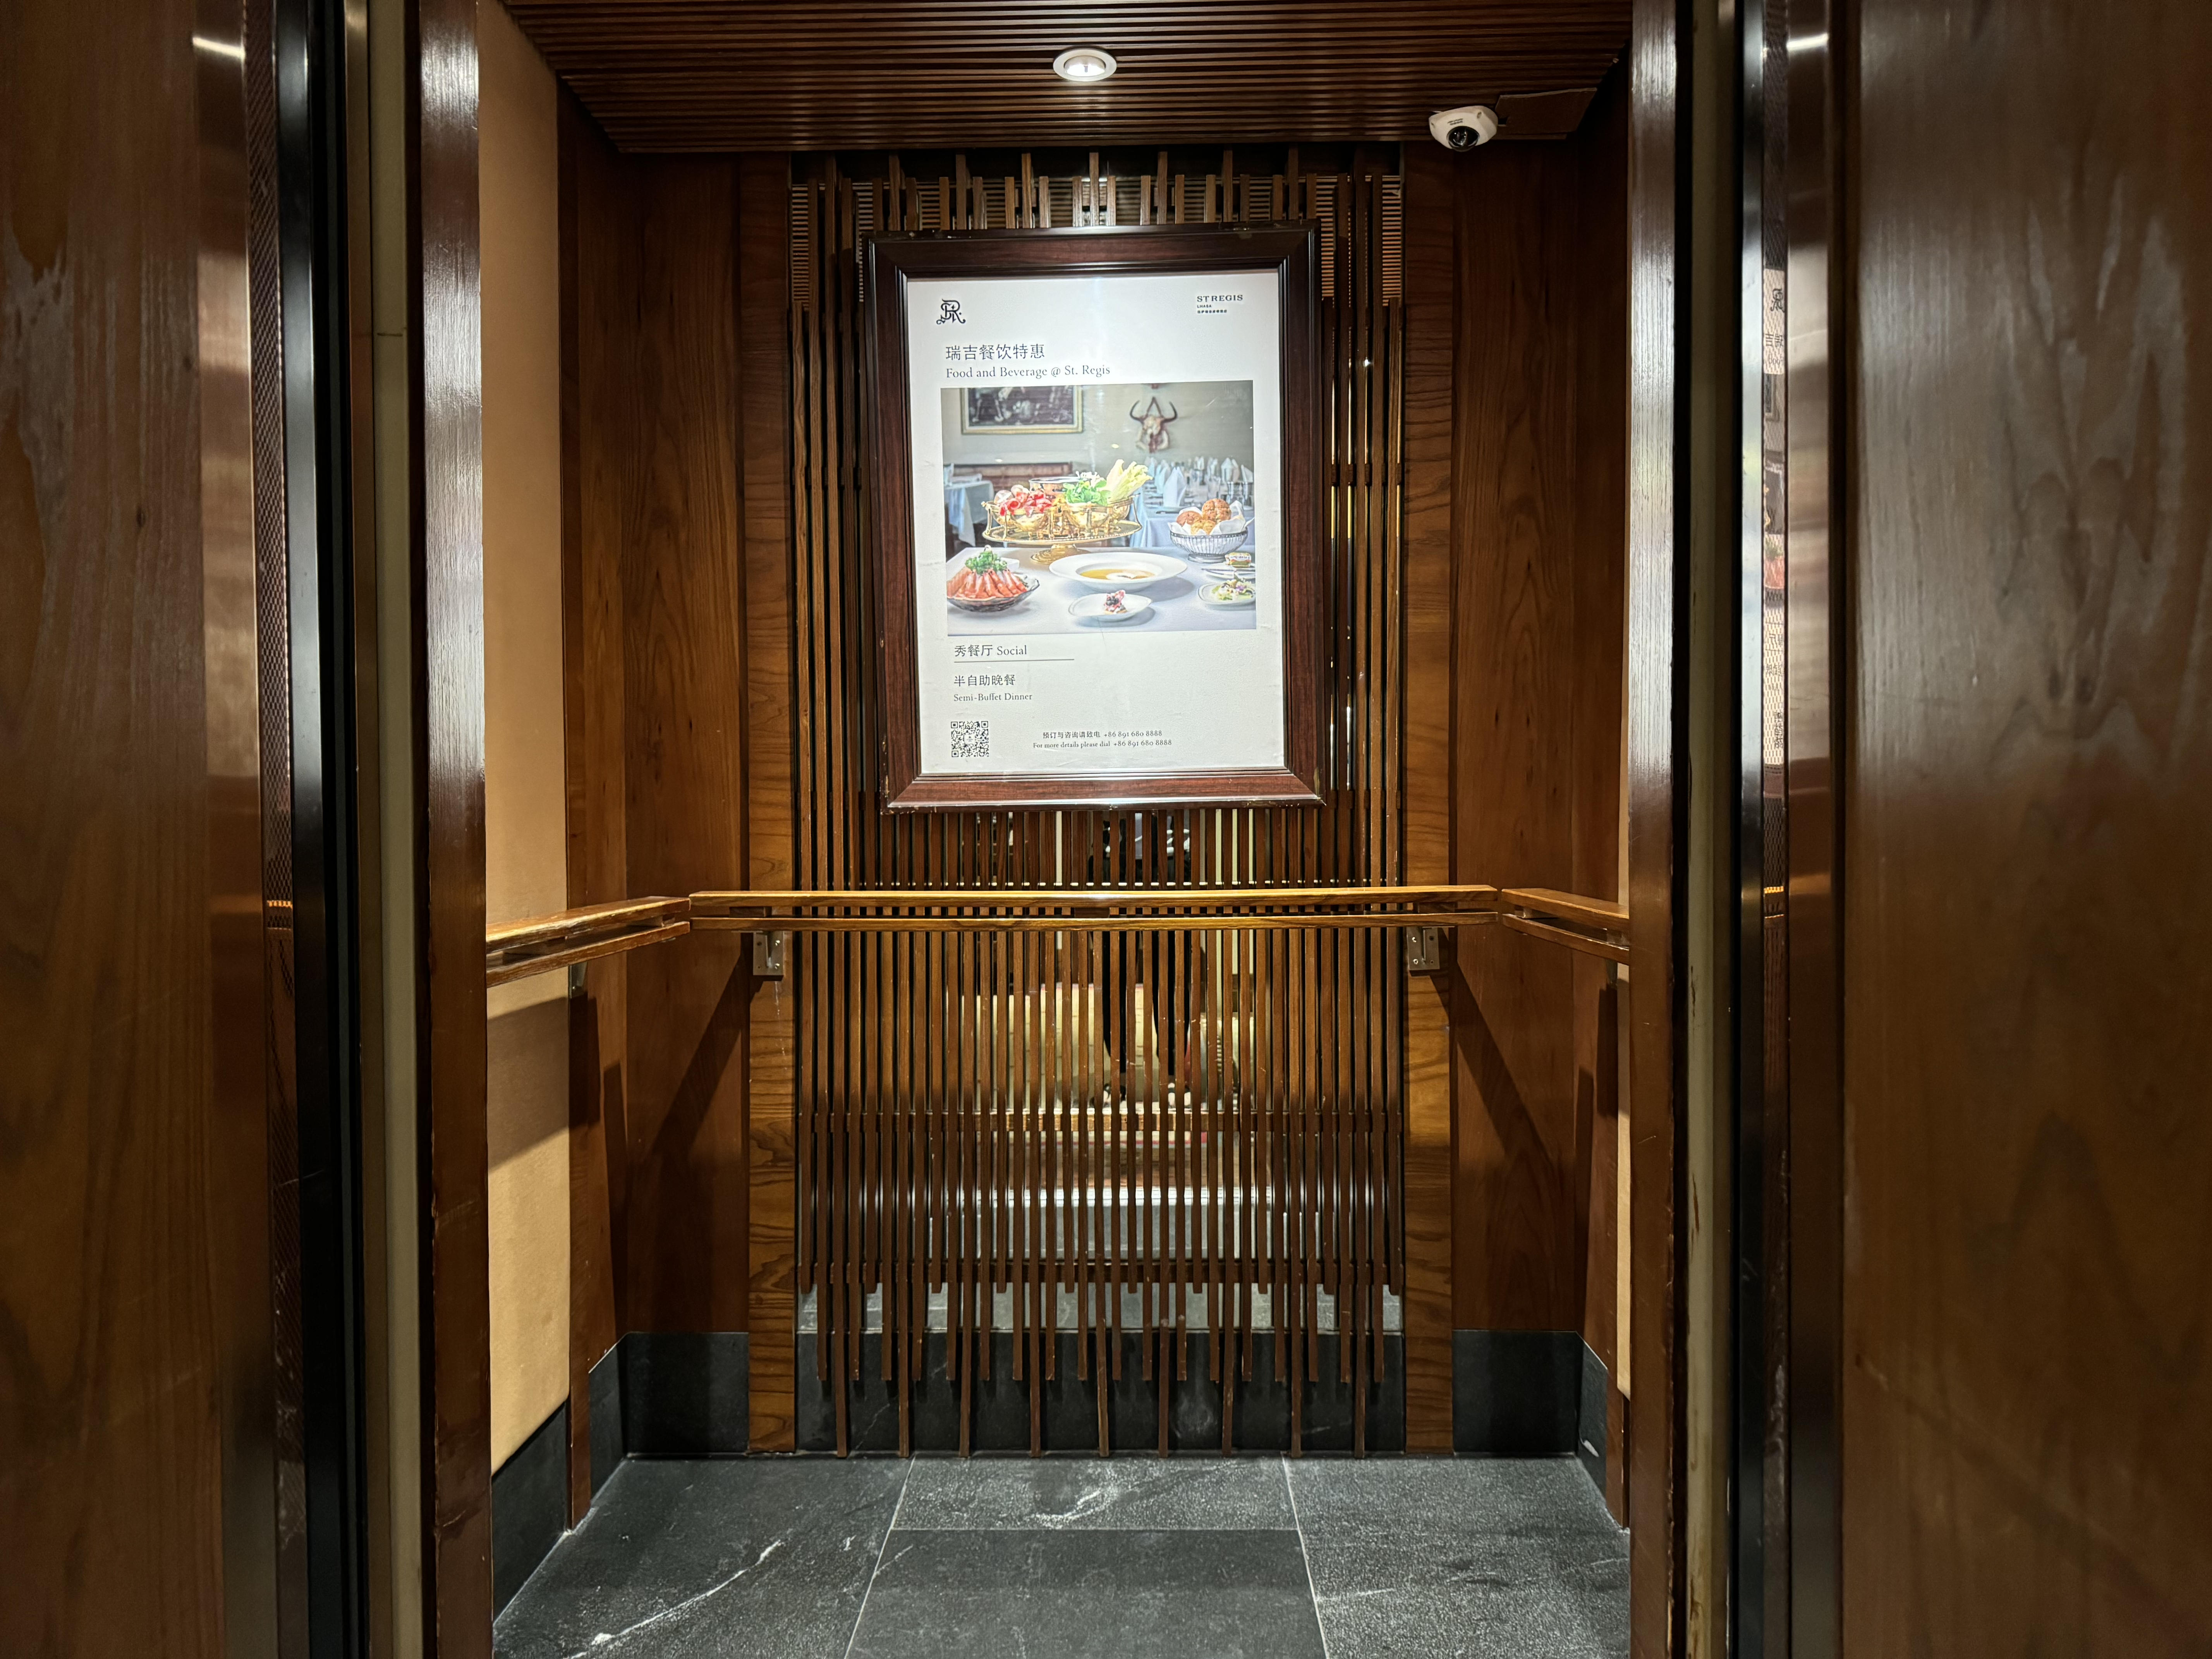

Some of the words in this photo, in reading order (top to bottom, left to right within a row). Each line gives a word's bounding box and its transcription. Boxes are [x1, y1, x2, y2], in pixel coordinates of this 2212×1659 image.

[945, 343, 1044, 361] 瑞吉餐饮特惠
[946, 367, 973, 378] Food
[976, 366, 996, 377] and
[1000, 367, 1047, 379] Beverage
[1051, 367, 1061, 377] @
[1065, 365, 1078, 375] St.
[1082, 365, 1110, 378] Regis
[954, 644, 993, 657] 秀餐厅
[997, 645, 1027, 655] Social
[954, 674, 1015, 687] 半自助晚餐
[954, 693, 1001, 701] Semi-Buffet
